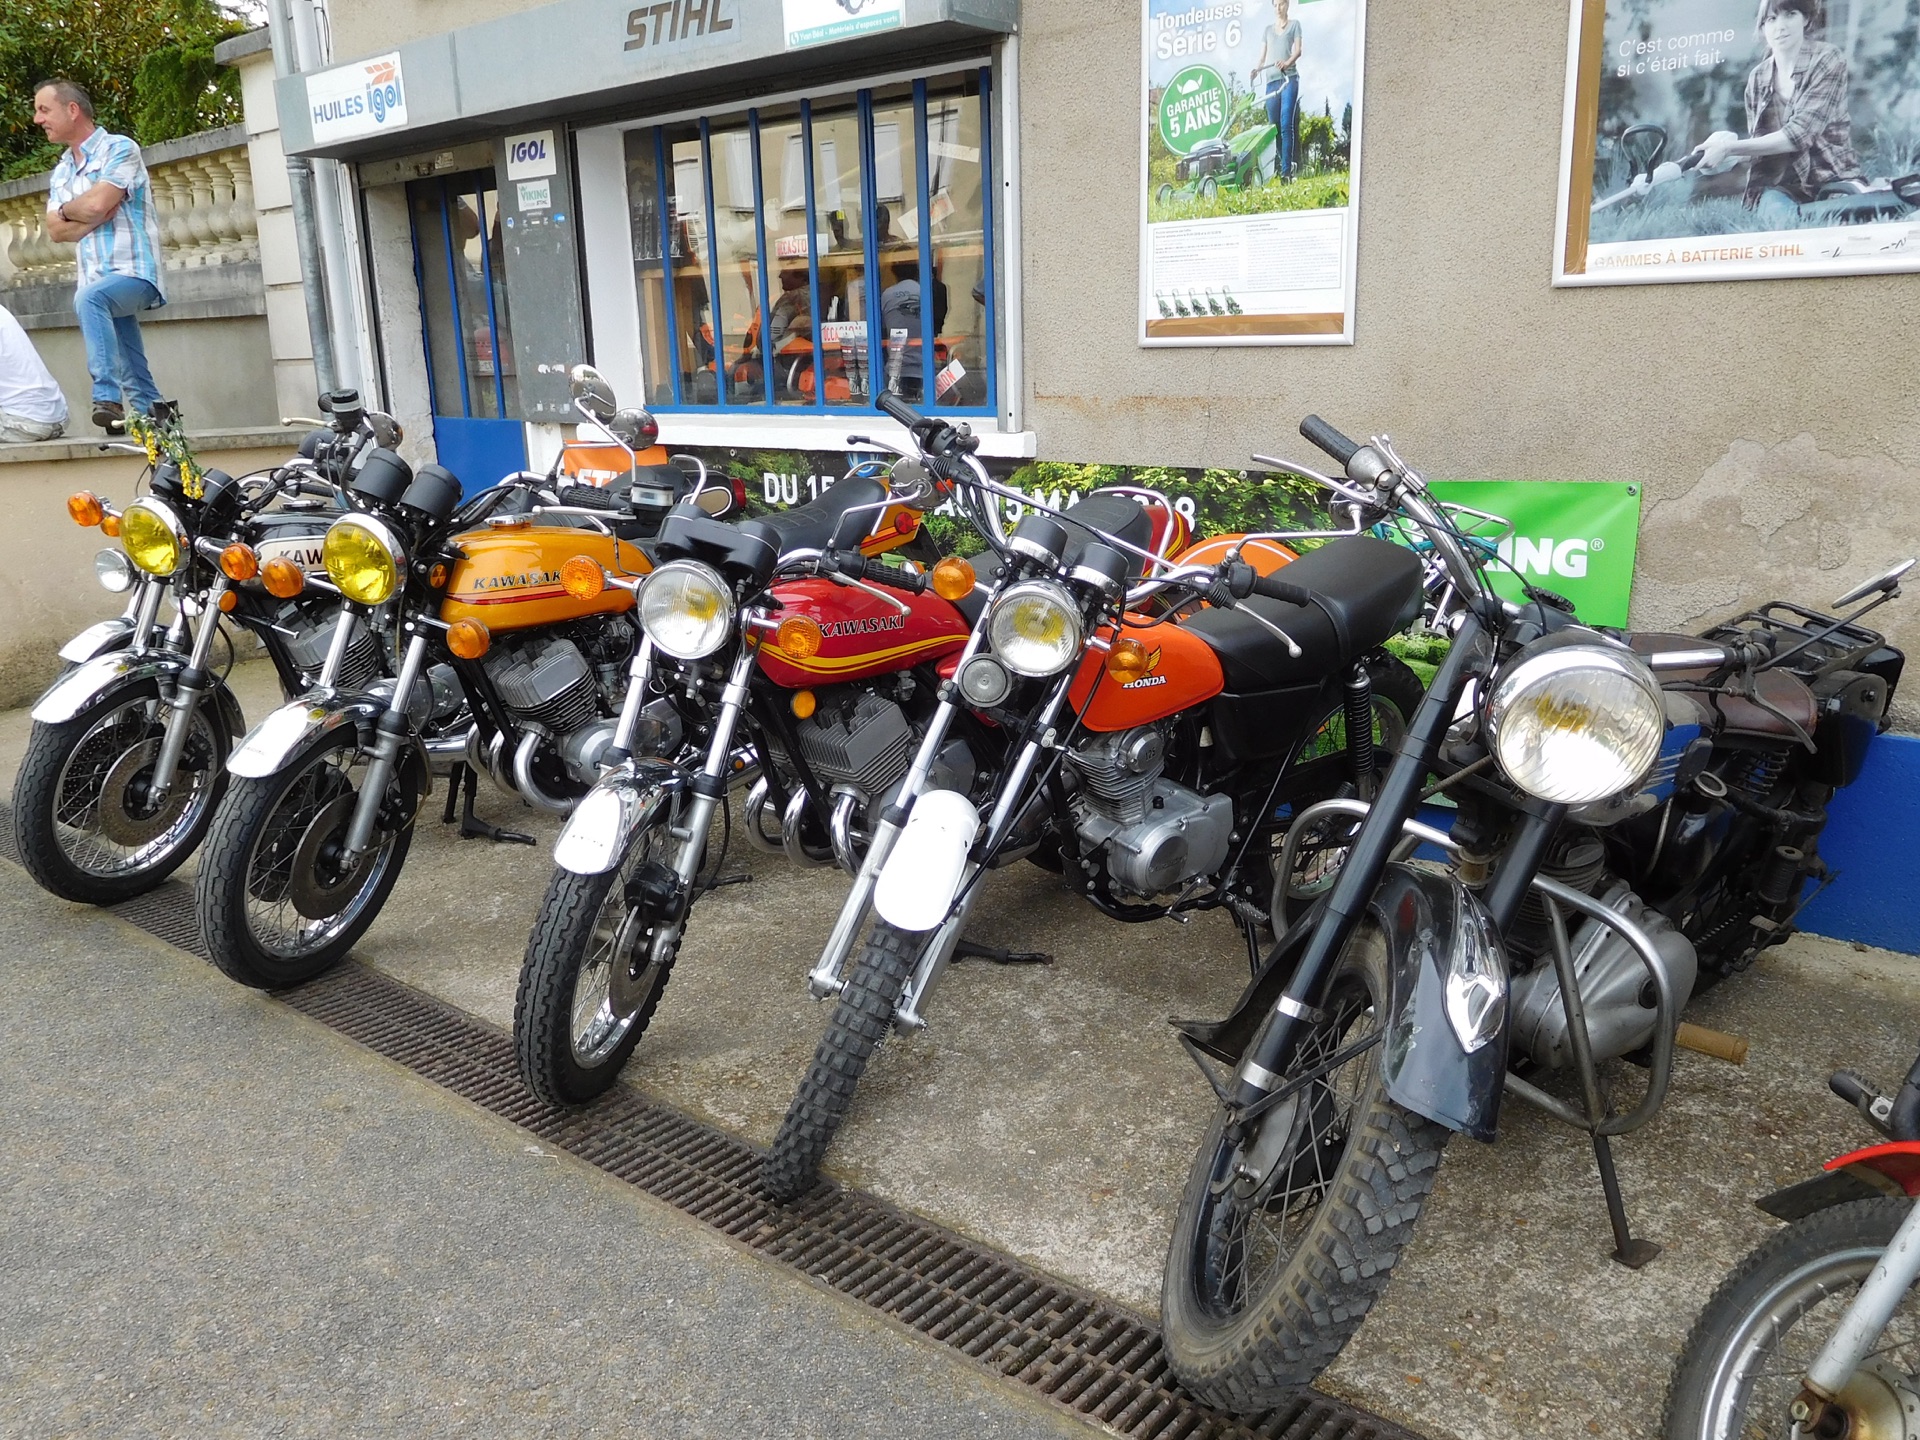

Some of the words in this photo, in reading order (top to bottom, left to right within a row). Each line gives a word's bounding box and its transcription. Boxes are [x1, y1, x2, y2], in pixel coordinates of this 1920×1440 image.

[623, 0, 734, 51] STIHL
[828, 24, 854, 35] Matériels
[855, 19, 882, 30] d'espaces
[883, 15, 898, 24] verts
[1156, 2, 1242, 31] Tondeuses
[1156, 25, 1217, 59] Série
[1225, 20, 1241, 48] 6
[1619, 36, 1662, 57] C'est
[1667, 28, 1735, 50] comme
[1616, 60, 1631, 77] si
[1635, 52, 1689, 74] c'était
[1694, 48, 1726, 67] fait.
[313, 95, 364, 124] HUILES
[365, 75, 403, 124] igol
[1169, 117, 1181, 138] 5
[1184, 101, 1222, 134] ANS
[510, 139, 546, 164] IGOL
[520, 189, 548, 201] VIKING
[777, 239, 808, 256] OCCASIO
[1594, 252, 1661, 267] GAMMES
[1666, 250, 1676, 264] À
[1681, 246, 1753, 263] BATTERIE
[1758, 243, 1805, 258] STIHL
[763, 472, 798, 505] DU
[474, 571, 560, 589] KAWASAK
[818, 614, 905, 638] KAWASAKI
